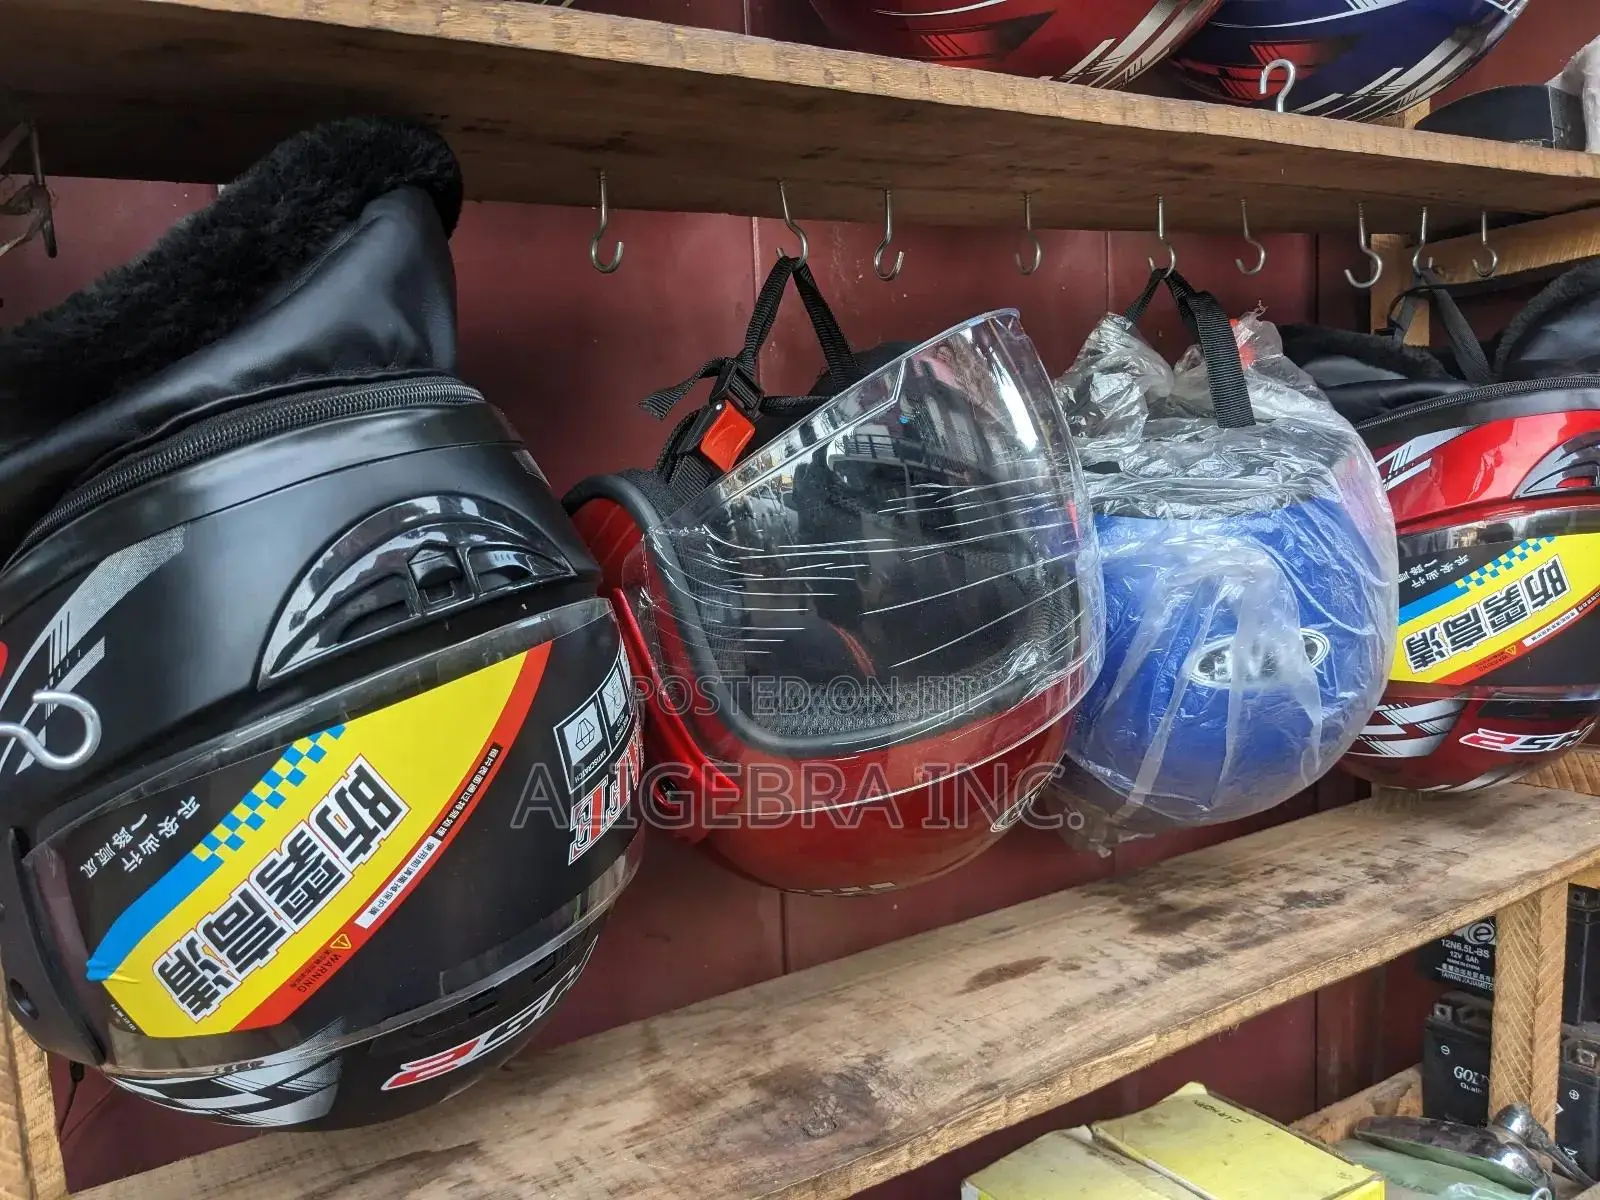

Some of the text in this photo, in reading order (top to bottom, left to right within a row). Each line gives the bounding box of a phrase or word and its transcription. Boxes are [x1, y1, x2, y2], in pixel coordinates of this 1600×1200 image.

[1411, 554, 1469, 588] 平安出行
[1404, 557, 1570, 672] 防雾高清
[80, 813, 148, 879] 一路顺风
[121, 795, 201, 873] 平安出行
[155, 757, 408, 1020] 防雾高清
[297, 953, 343, 994] WARNING
